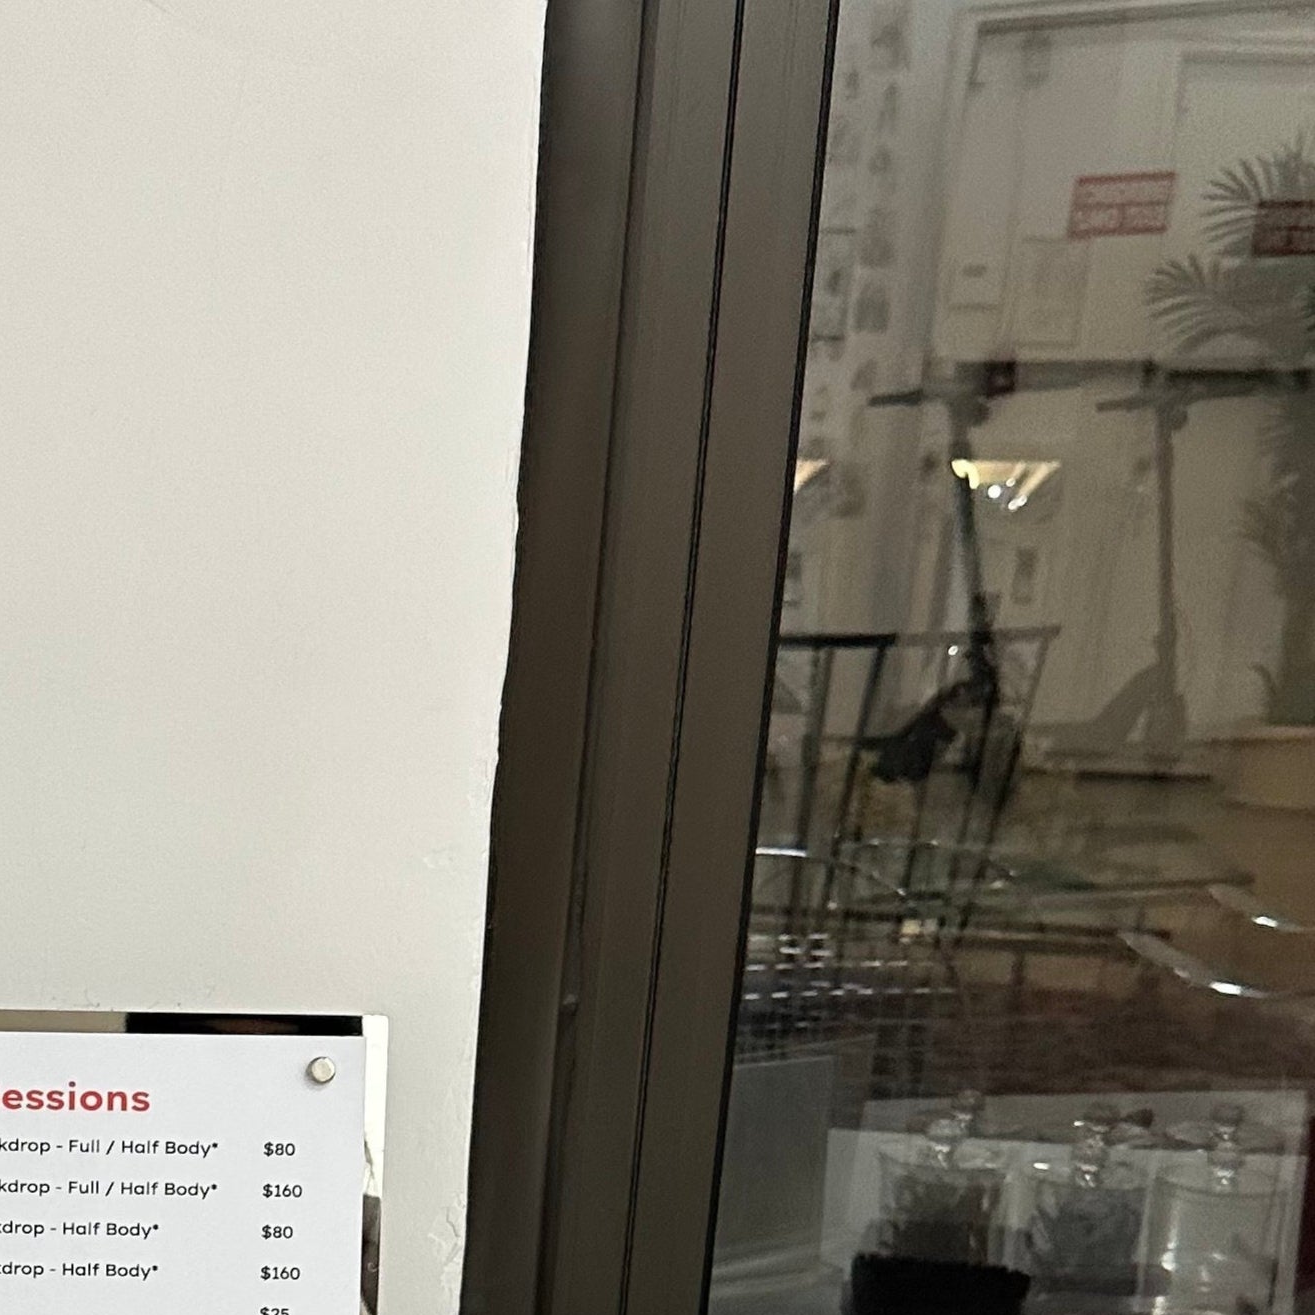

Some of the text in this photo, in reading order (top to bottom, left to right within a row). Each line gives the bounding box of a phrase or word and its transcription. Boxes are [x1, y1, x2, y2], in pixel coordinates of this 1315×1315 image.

[68, 1139, 100, 1153] Full
[121, 1140, 160, 1154] Half
[264, 1142, 295, 1157] $80
[68, 1180, 100, 1195] Full
[120, 1181, 159, 1196] Half
[263, 1184, 302, 1198] $160
[62, 1221, 101, 1236] Half
[262, 1225, 293, 1239] $80
[62, 1262, 100, 1277] Half
[261, 1266, 300, 1280] $160
